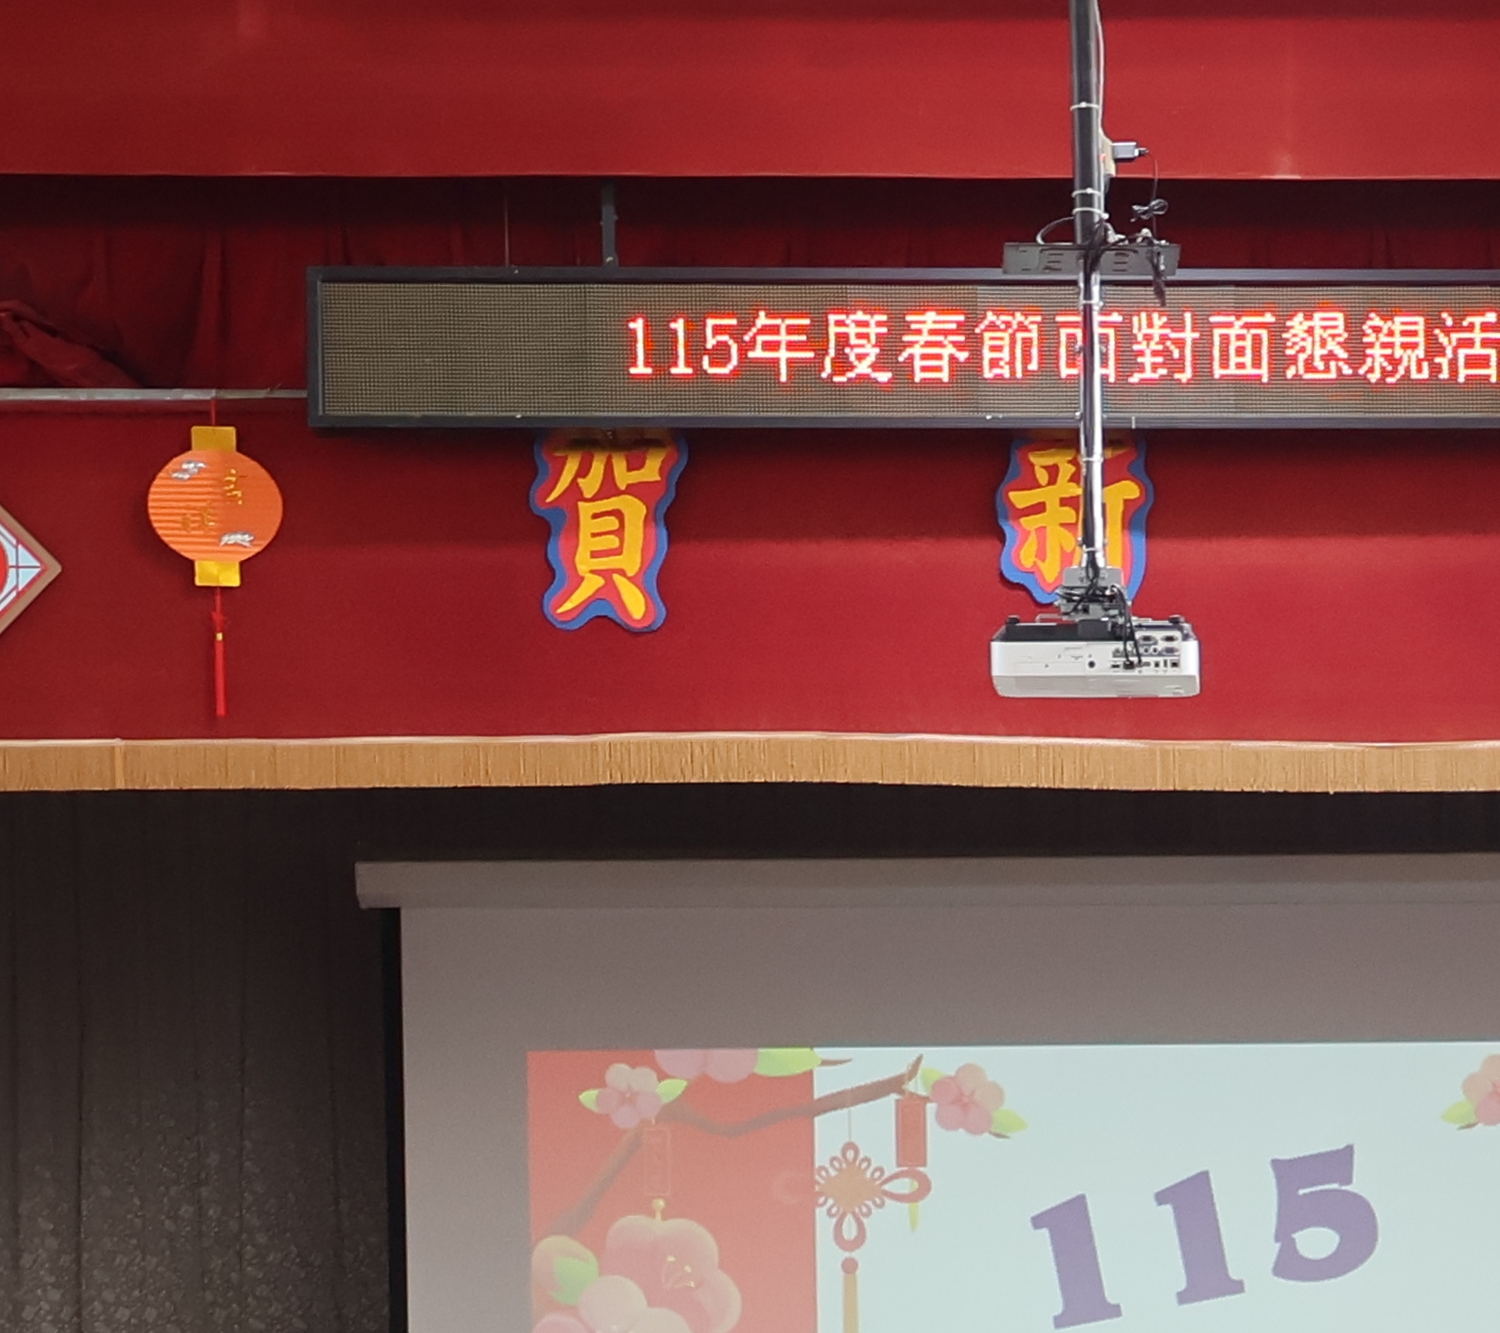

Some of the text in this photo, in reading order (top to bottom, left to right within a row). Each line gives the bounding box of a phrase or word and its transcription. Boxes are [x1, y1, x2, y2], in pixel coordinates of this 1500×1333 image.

[546, 451, 667, 619] 賀
[1008, 448, 1141, 582] 新
[1030, 1143, 1379, 1331] 115
